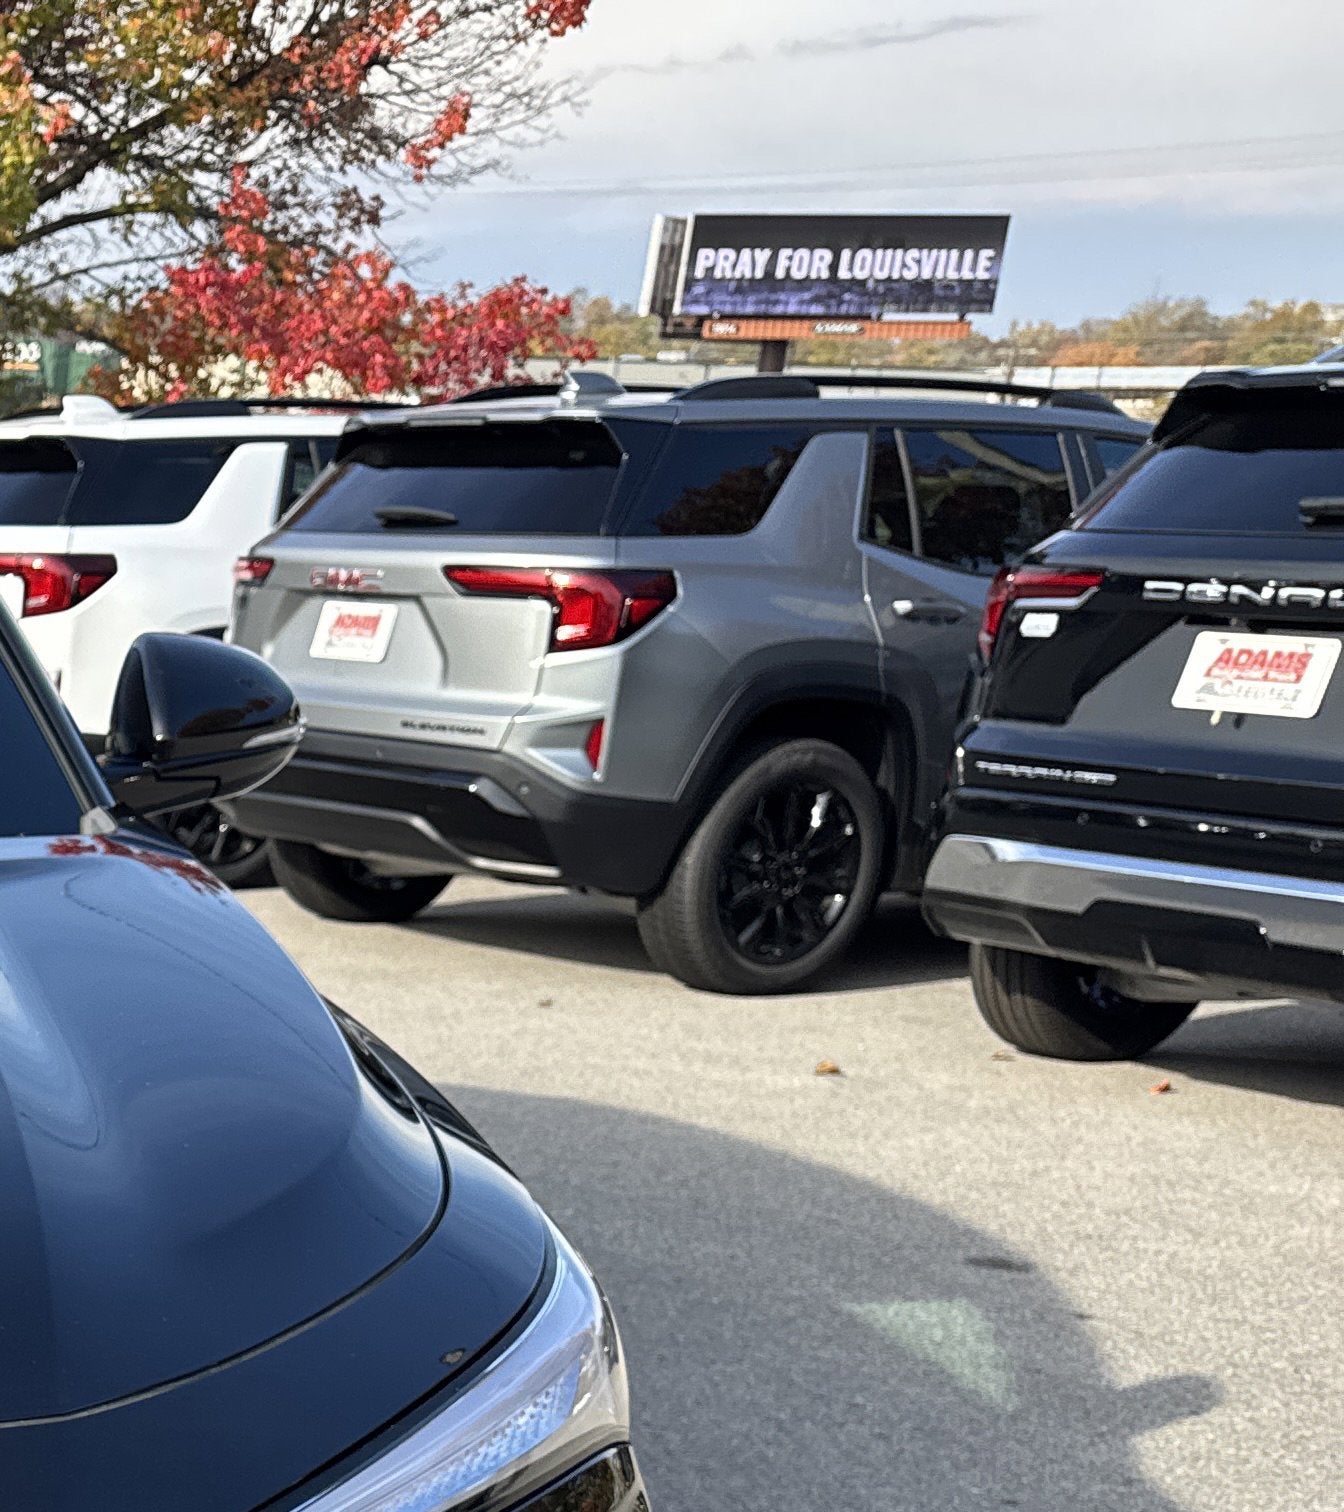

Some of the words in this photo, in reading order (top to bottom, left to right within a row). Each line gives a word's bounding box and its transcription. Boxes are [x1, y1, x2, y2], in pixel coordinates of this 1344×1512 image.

[694, 246, 773, 281] PRAY
[774, 246, 836, 281] FOR
[836, 246, 996, 281] LOUISVILLE
[1210, 647, 1313, 671] ADAMS
